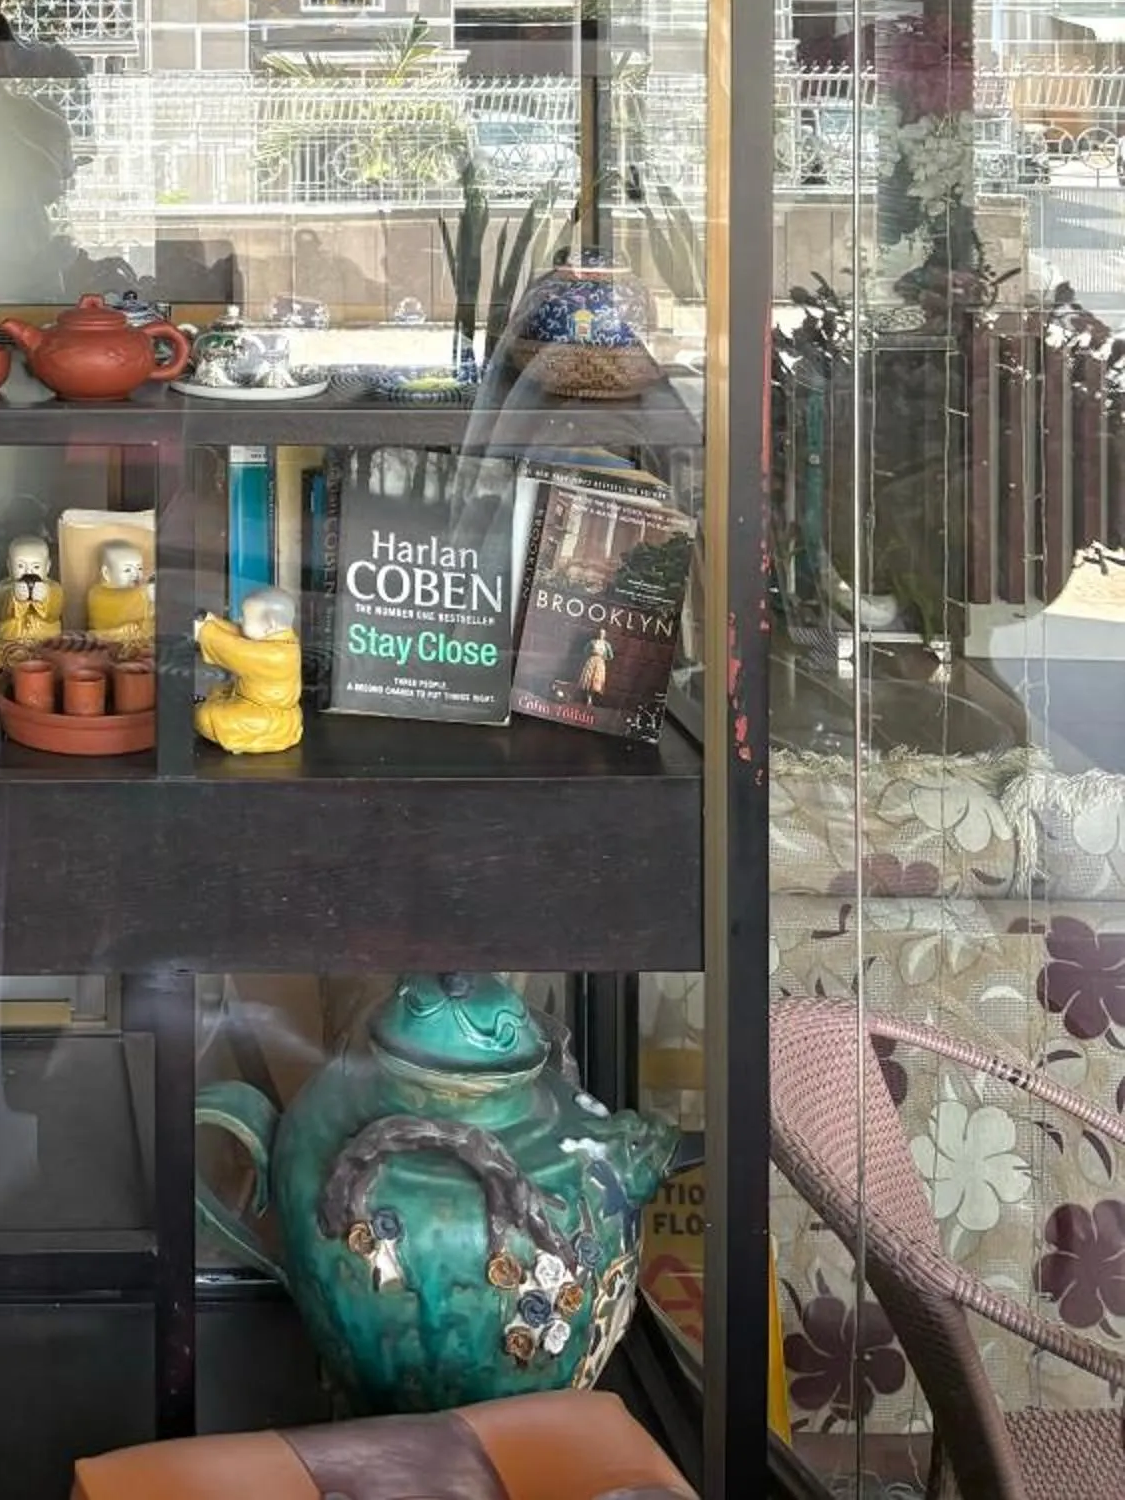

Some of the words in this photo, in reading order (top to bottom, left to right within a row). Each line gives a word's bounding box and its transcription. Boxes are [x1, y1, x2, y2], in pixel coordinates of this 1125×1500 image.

[372, 530, 478, 568] Harlan
[346, 560, 503, 613] COBEN
[354, 603, 372, 614] THE
[375, 605, 414, 619] NUMBER
[438, 613, 496, 626] BESTSELLER
[536, 589, 675, 637] BROOKLYN
[348, 623, 413, 666] Stay
[418, 631, 498, 667] Close
